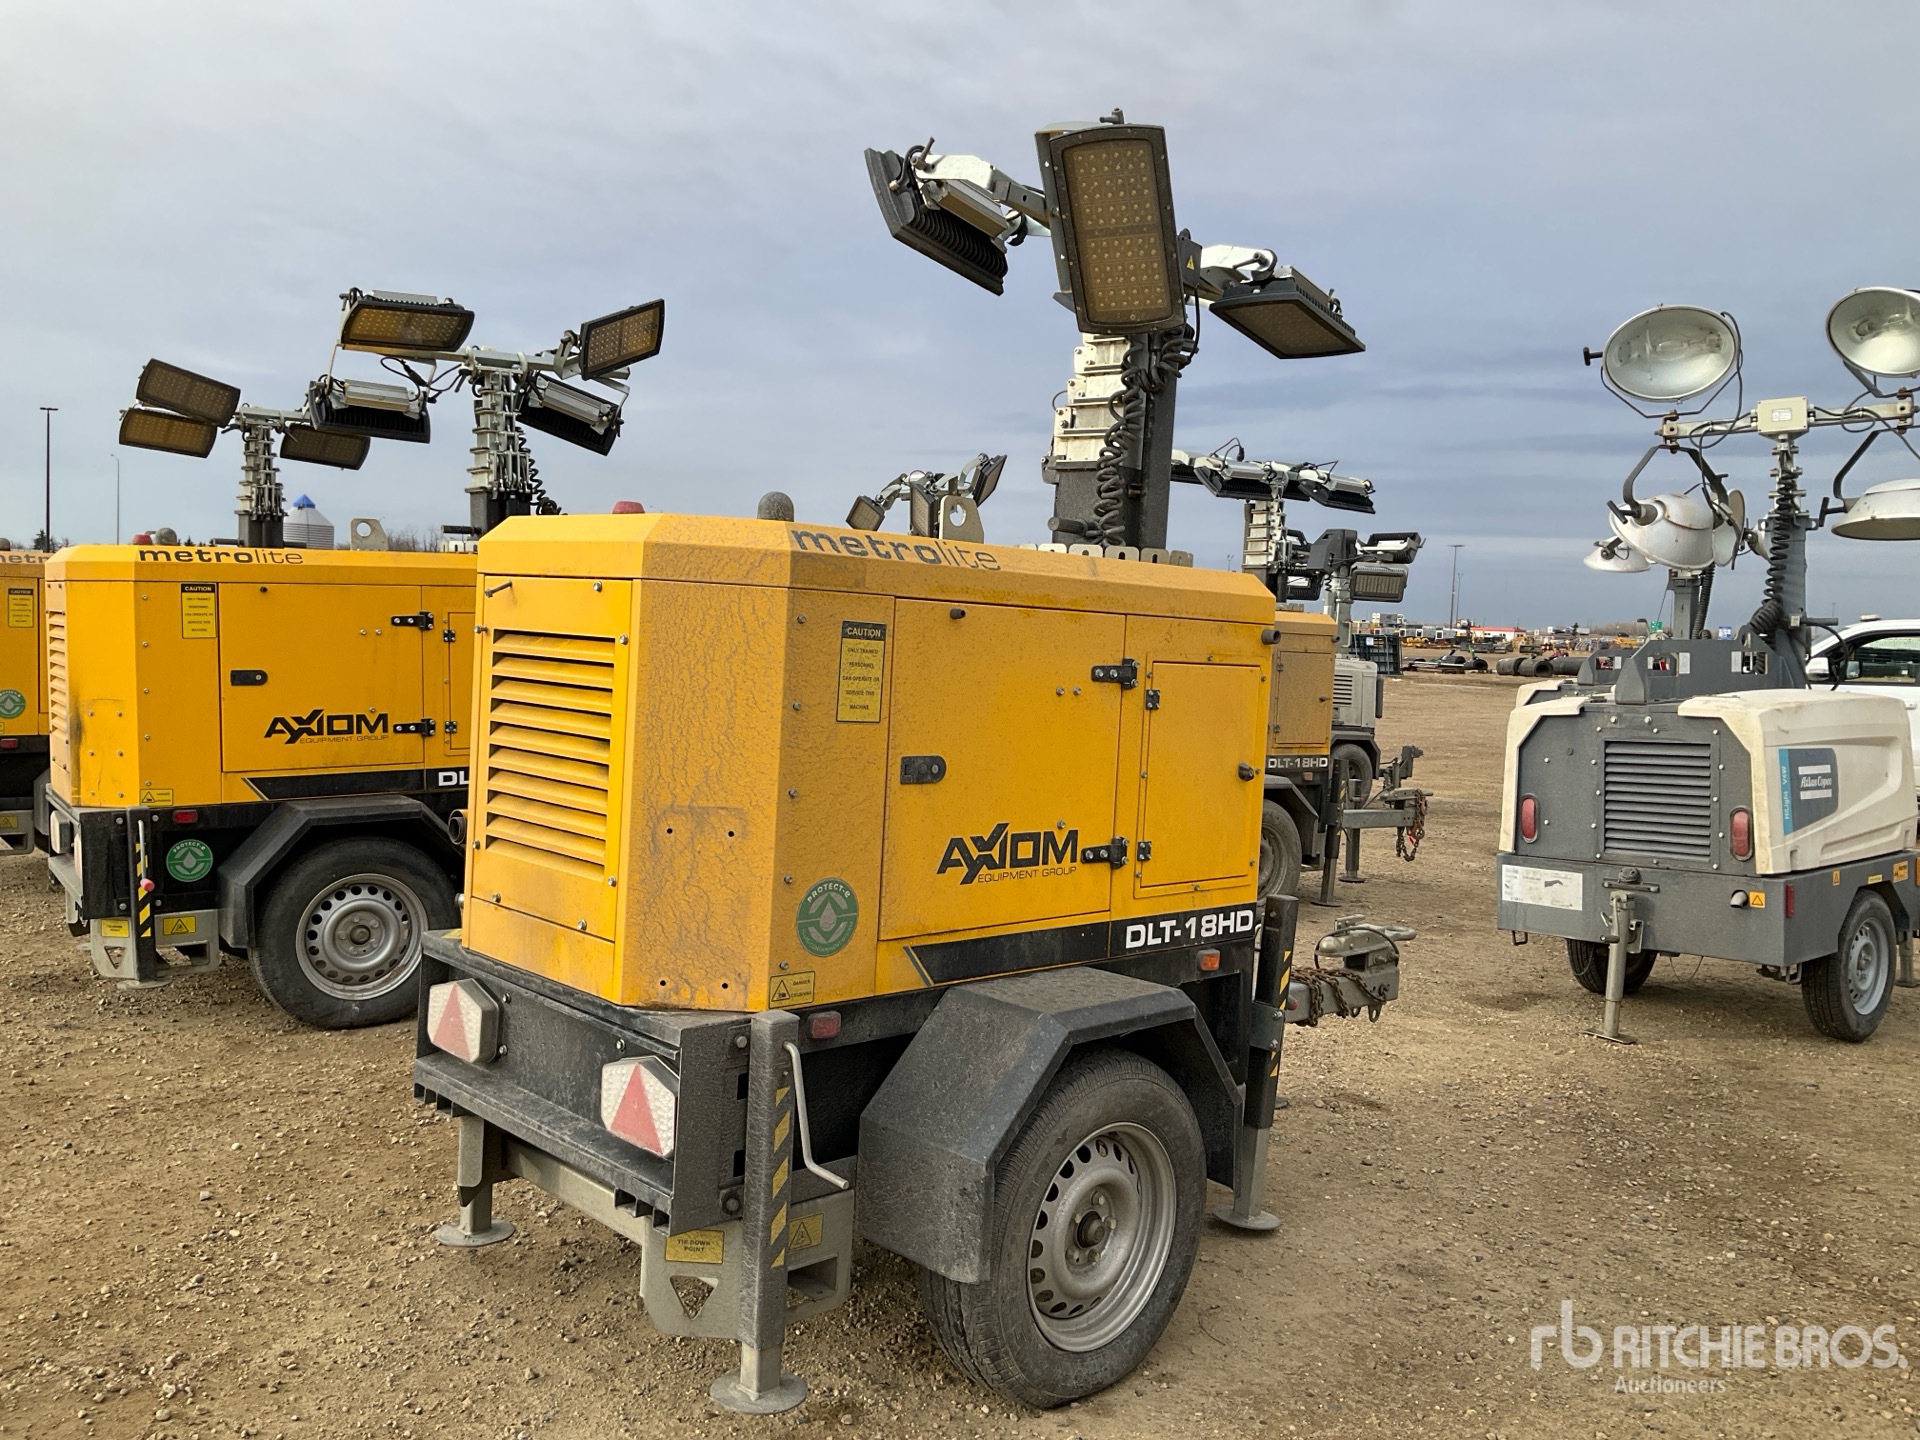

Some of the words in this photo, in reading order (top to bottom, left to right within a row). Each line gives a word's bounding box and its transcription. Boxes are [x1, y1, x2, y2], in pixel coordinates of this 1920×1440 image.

[139, 549, 304, 565] metrolite
[791, 530, 1002, 571] metrolite
[847, 627, 881, 637] CAUTION
[264, 709, 389, 745] AXIOM
[300, 736, 353, 744] EQUIPMENT
[1268, 757, 1329, 768] DLT-18HD
[936, 822, 1079, 885] AXIOM
[978, 869, 1038, 883] EQUIPMENT
[1042, 866, 1077, 877] GROUP
[1126, 909, 1253, 949] DLT-18HD
